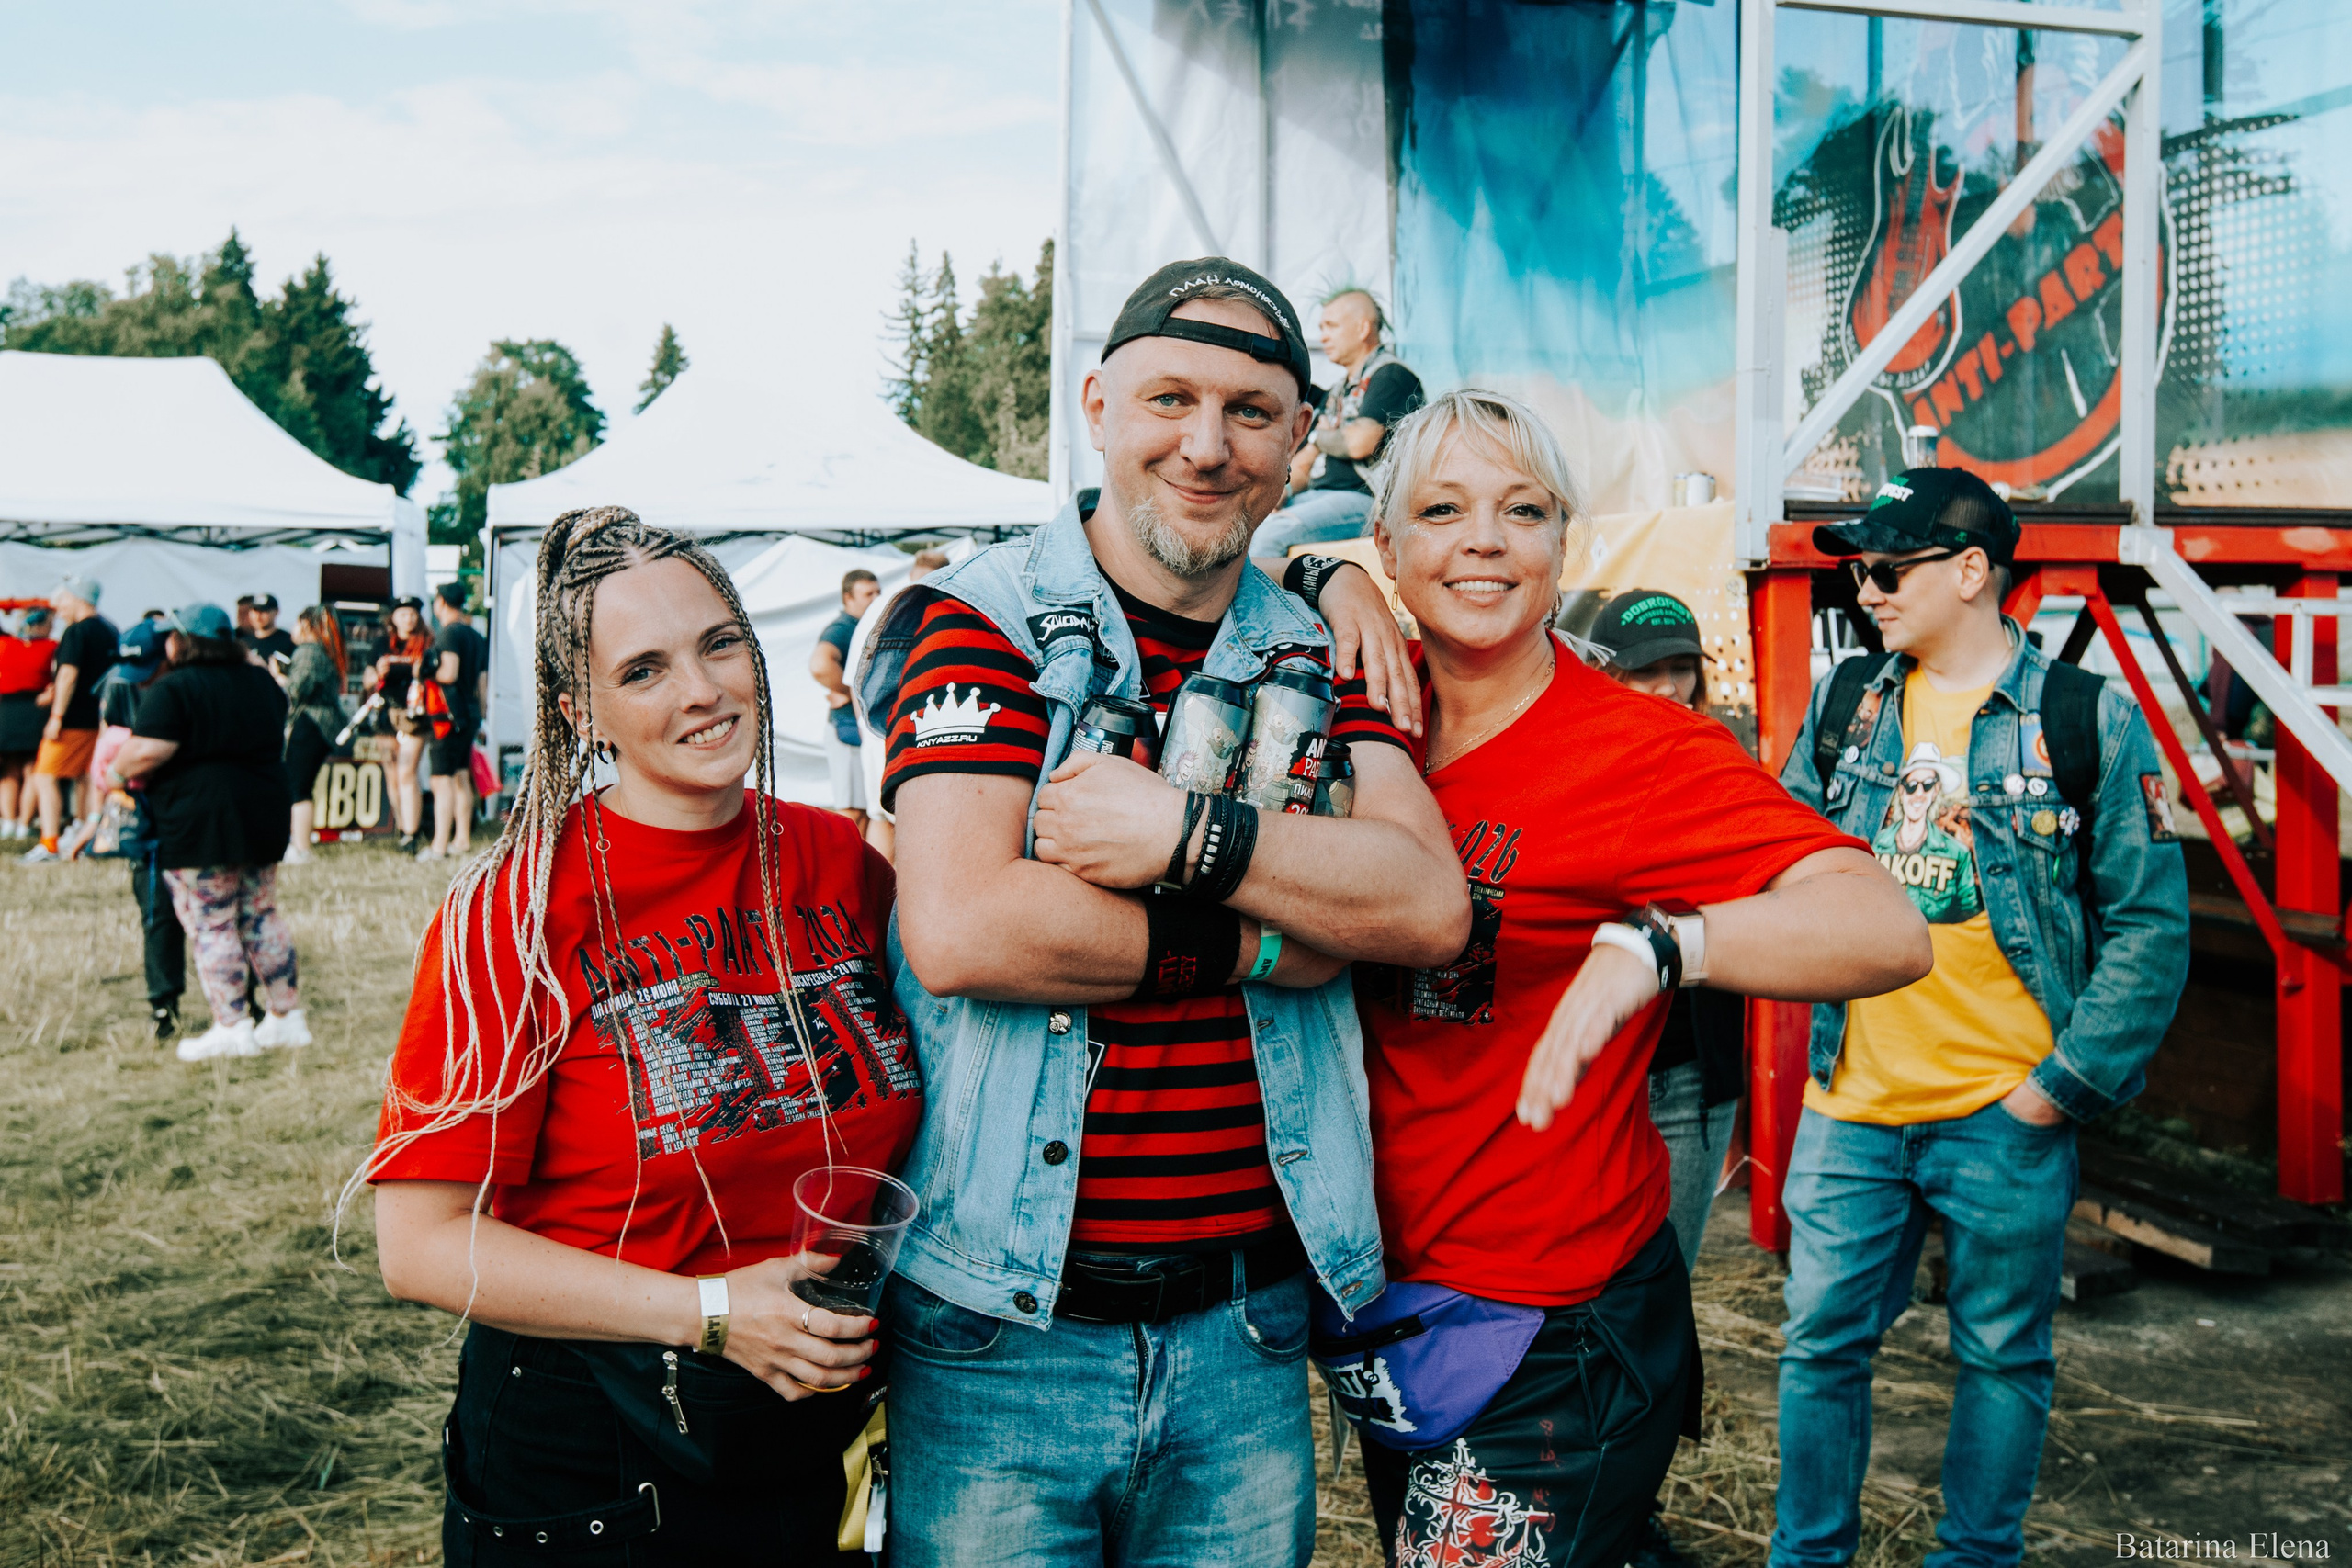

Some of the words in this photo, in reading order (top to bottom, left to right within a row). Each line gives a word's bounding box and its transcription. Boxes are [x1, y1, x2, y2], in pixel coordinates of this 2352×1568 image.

[1169, 275, 1219, 297] ПЛАН
[1908, 204, 2123, 434] ANTI-PART
[916, 734, 978, 748] KNYAZZ.RU
[1452, 820, 1523, 884] 026
[834, 963, 850, 977] 28
[636, 989, 651, 1003] 26
[650, 979, 680, 1000] ИЮНЯ
[741, 995, 752, 1007] 27
